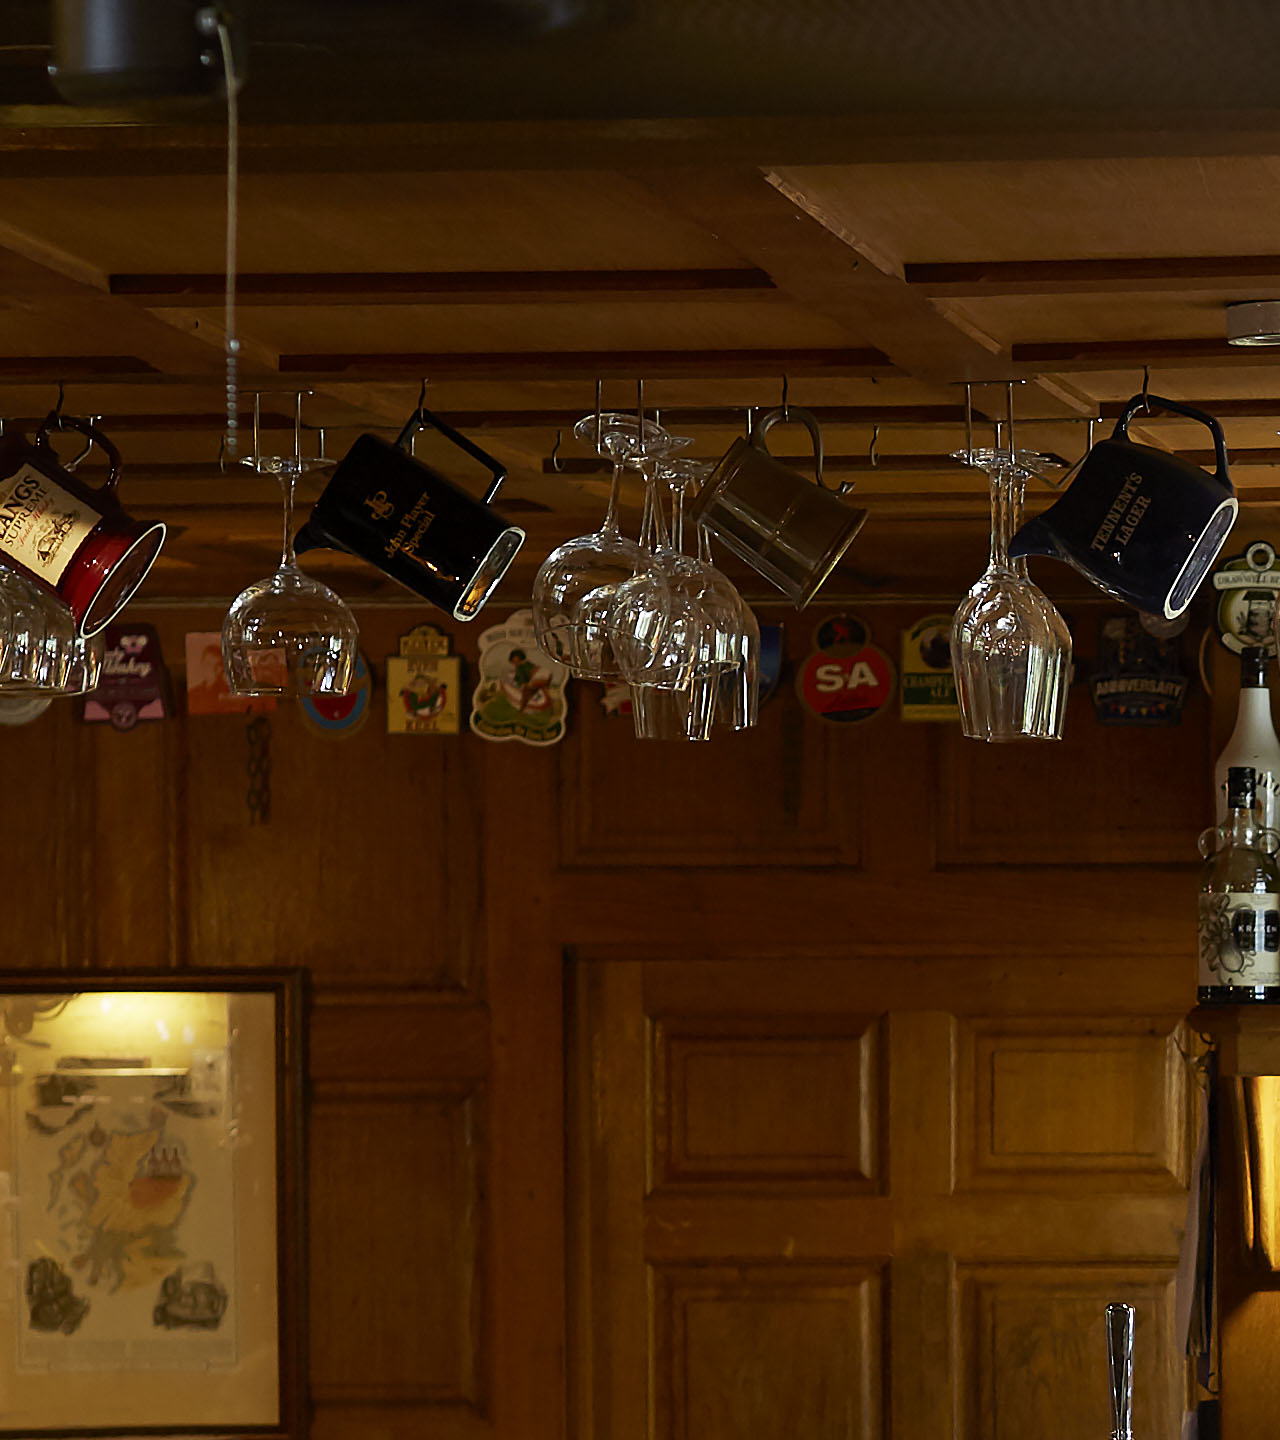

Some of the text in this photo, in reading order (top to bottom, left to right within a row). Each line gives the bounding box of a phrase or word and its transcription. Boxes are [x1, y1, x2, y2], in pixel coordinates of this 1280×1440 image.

[384, 490, 432, 560] John Player
[401, 510, 437, 555] Special
[1090, 471, 1144, 553] TENNENT'S
[1113, 495, 1152, 548] LAGER
[814, 660, 880, 693] SA
[1091, 678, 1187, 698] ANNIVERSARY
